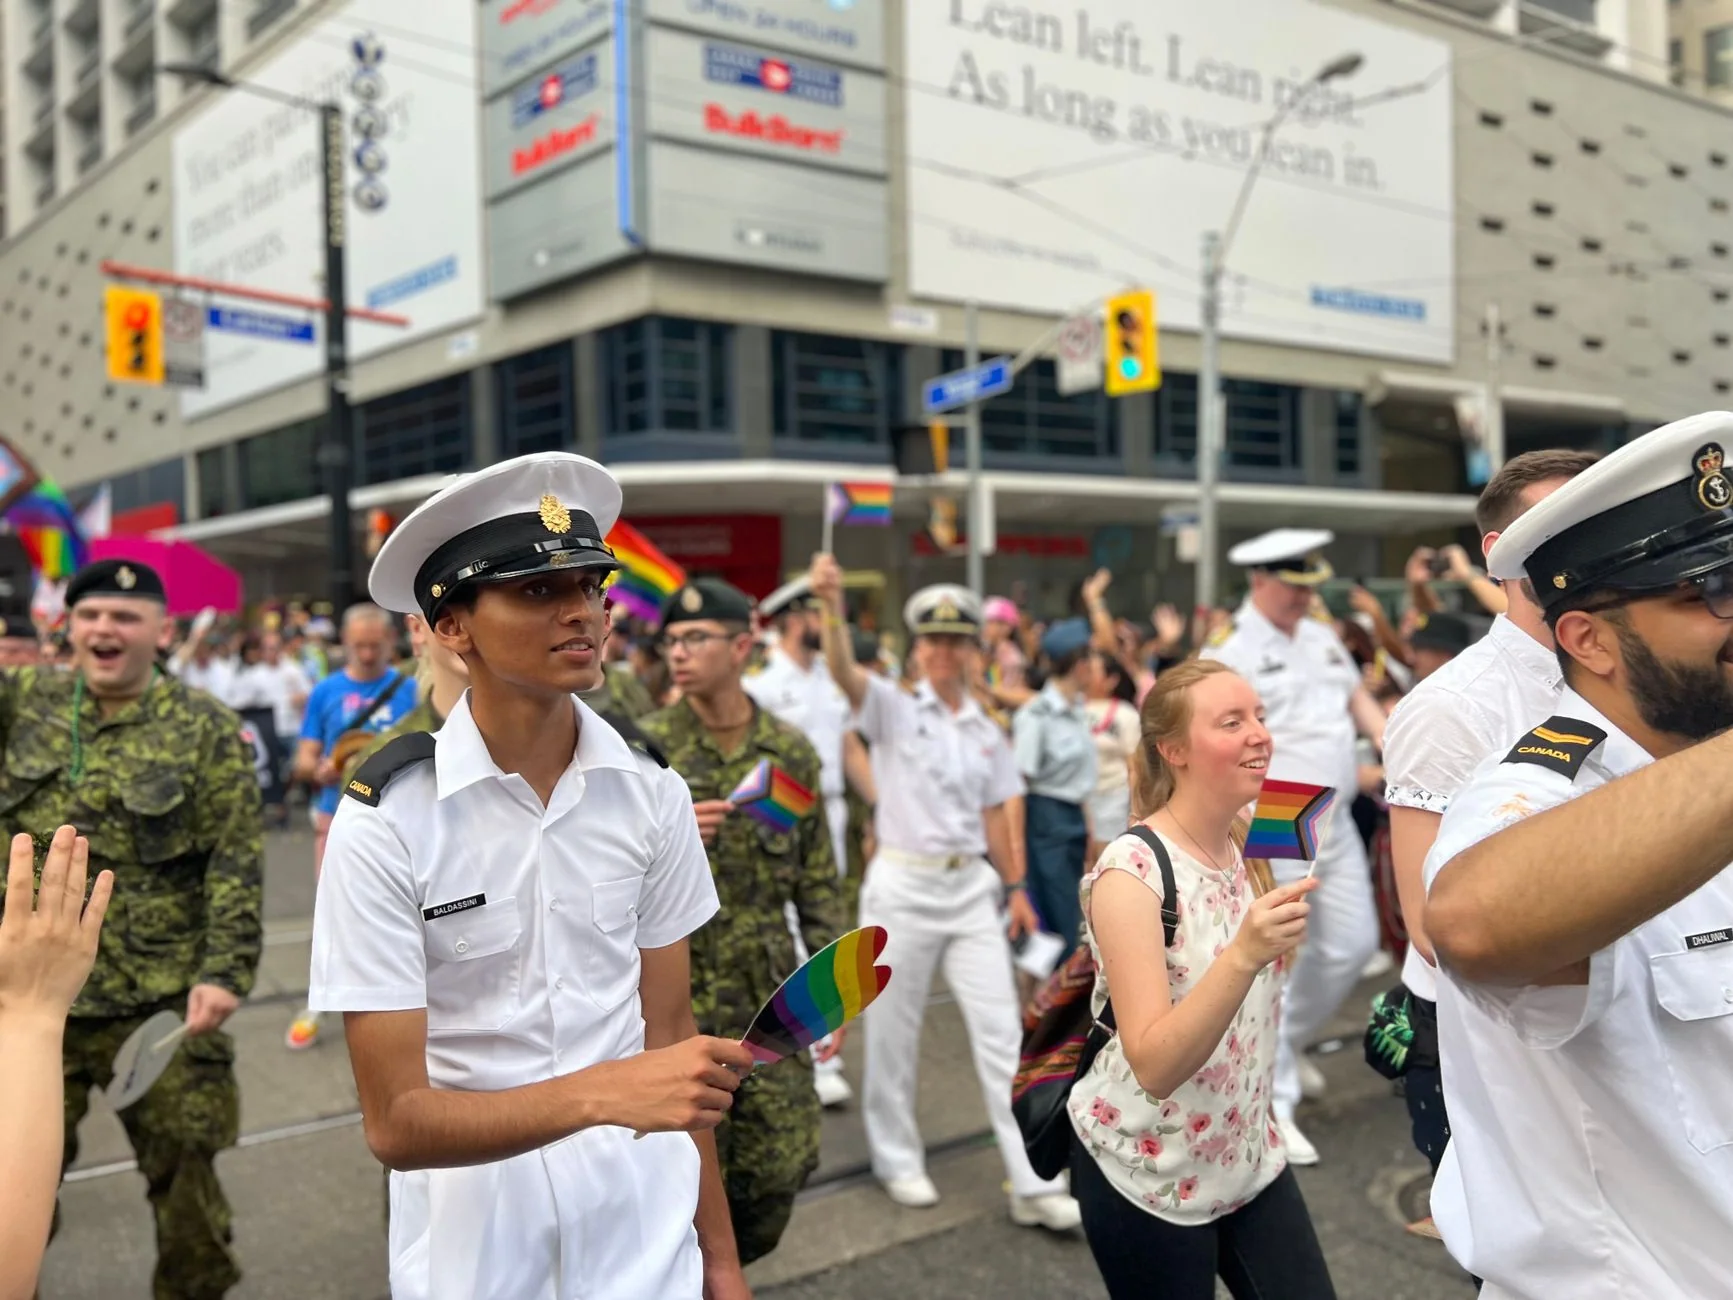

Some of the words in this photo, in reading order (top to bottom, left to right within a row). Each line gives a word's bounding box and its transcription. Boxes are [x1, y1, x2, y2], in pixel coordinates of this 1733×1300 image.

[948, 48, 1009, 110] As
[1022, 64, 1119, 145] long
[1127, 104, 1172, 143] as
[1181, 115, 1249, 162] you
[1517, 746, 1571, 763] CANADA
[349, 780, 372, 797] CANADA
[433, 898, 478, 916] BALDASSINI
[1692, 931, 1729, 946] DHALIWAL
